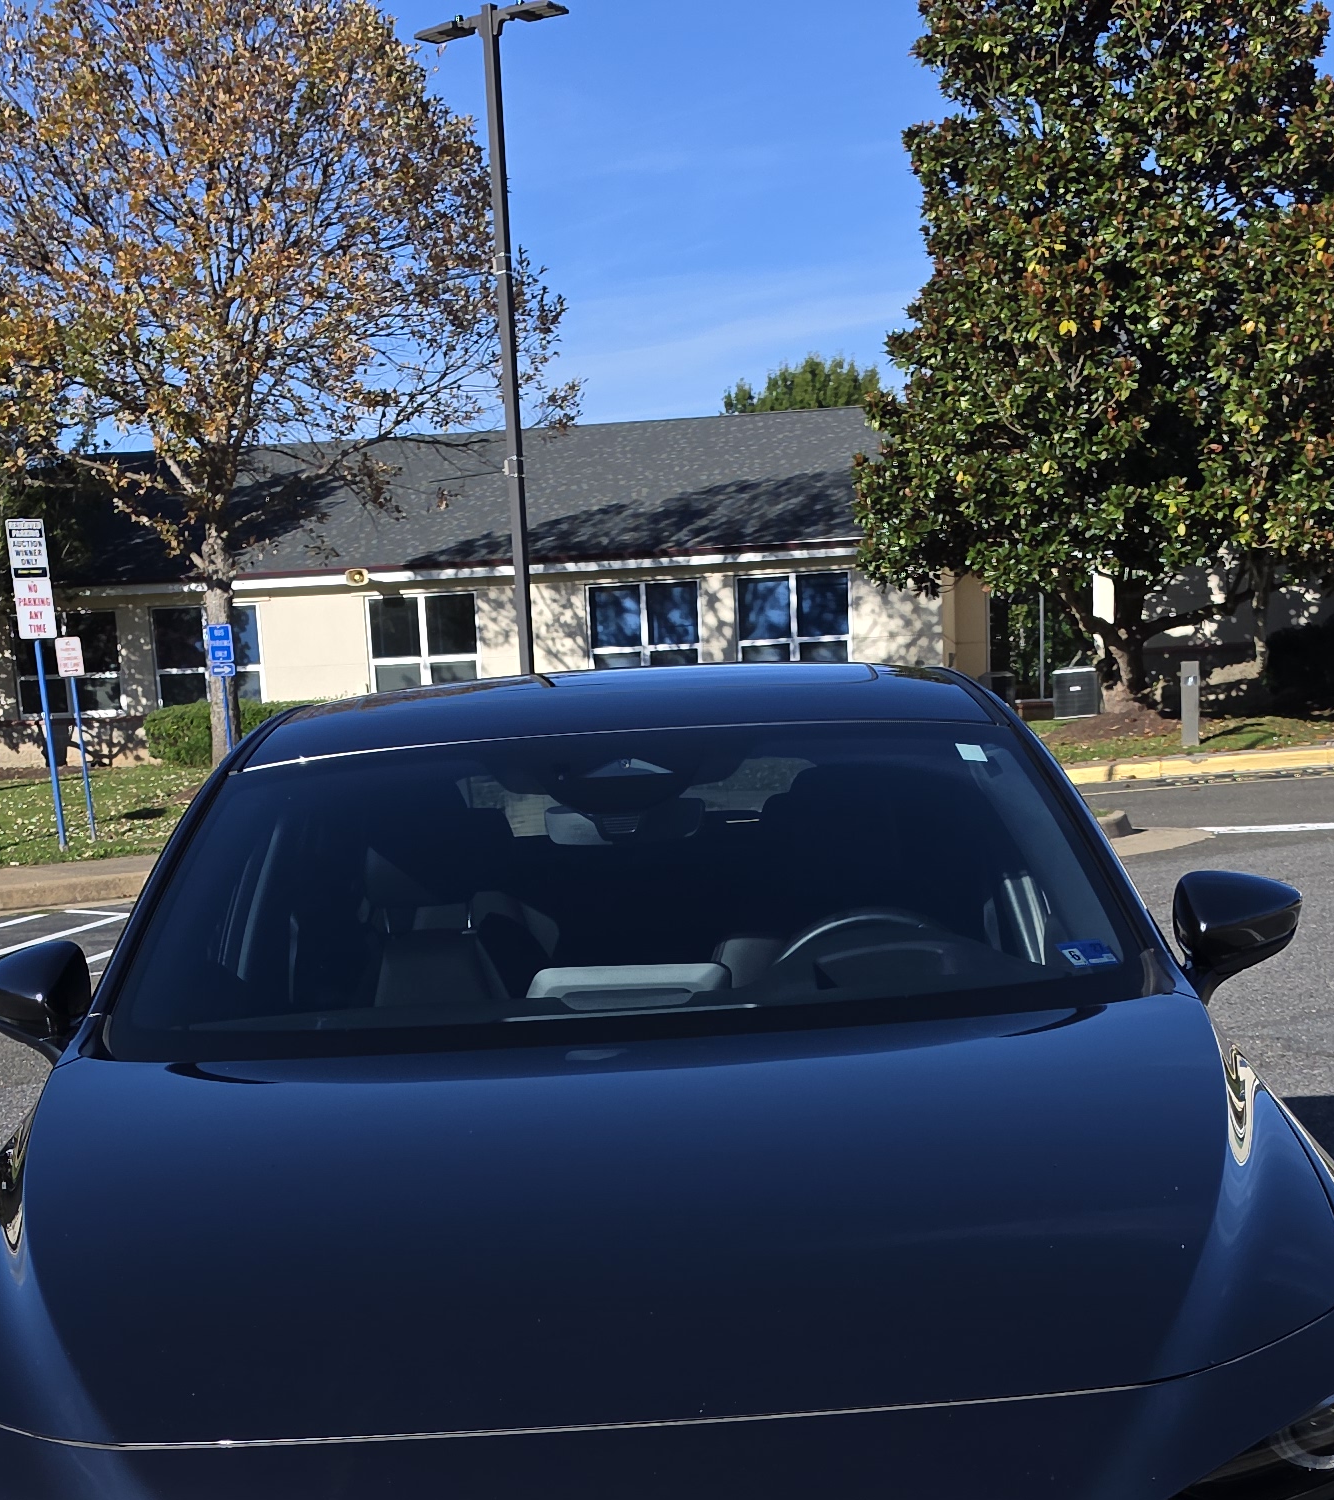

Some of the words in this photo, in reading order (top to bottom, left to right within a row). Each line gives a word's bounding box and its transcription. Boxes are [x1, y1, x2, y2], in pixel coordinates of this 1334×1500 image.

[12, 540, 43, 548] AUCTION
[14, 549, 43, 557] WINNER
[20, 558, 39, 566] ONLY
[27, 583, 38, 594] NO
[17, 597, 51, 607] PARKING
[29, 611, 44, 620] ANY
[28, 624, 47, 634] TIME
[1067, 950, 1081, 961] 6
